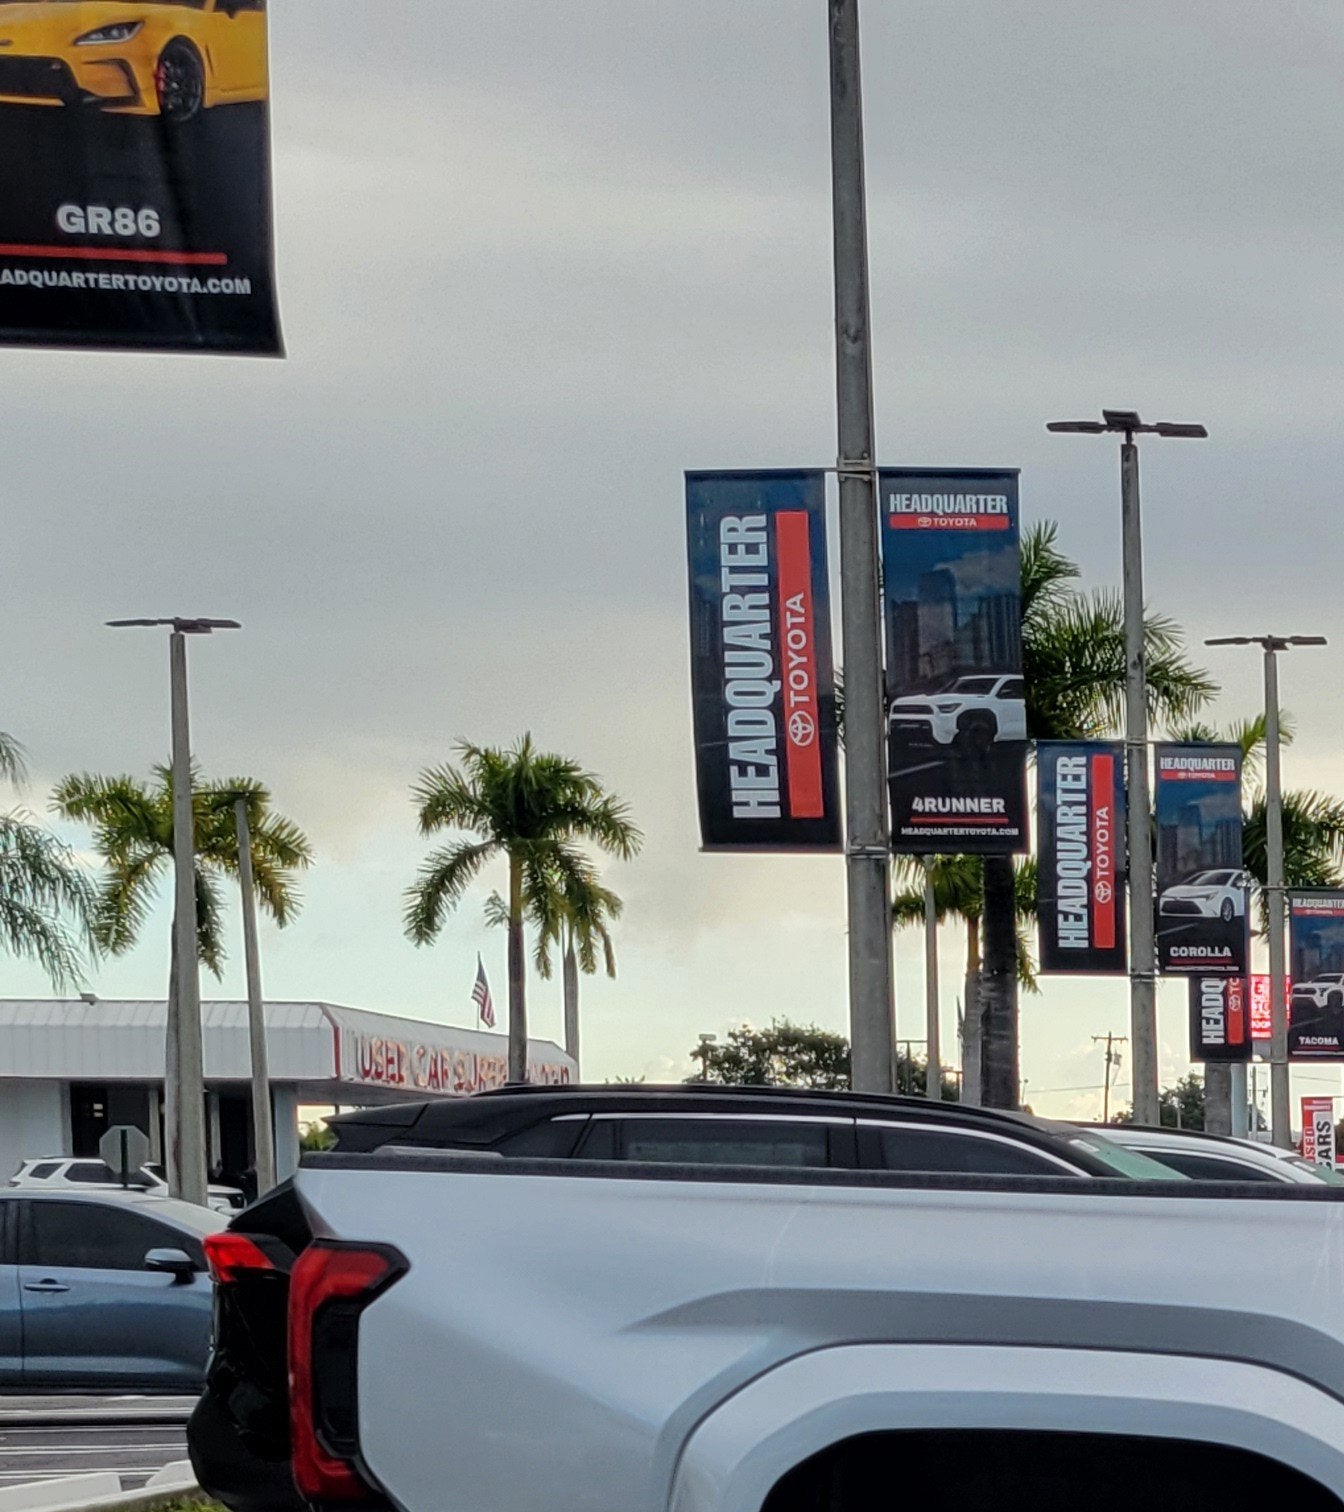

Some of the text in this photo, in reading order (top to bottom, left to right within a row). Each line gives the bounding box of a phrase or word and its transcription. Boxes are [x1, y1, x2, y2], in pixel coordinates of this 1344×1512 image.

[57, 204, 161, 238] GR86
[889, 493, 1009, 515] HEADQUARTER
[934, 517, 978, 527] TOYOTA
[720, 513, 782, 819] HEADQUARTER
[785, 592, 810, 708] TOYOTA
[1160, 756, 1236, 772] HEADQUARTER
[912, 796, 1005, 813] 4RUNNER
[1056, 755, 1092, 948] HEADQUARTER
[1096, 806, 1109, 878] TOYOTA
[1169, 946, 1232, 957] COROLLA
[1200, 977, 1227, 1044] HEADQ
[1298, 1036, 1339, 1045] TACOMA
[356, 1034, 406, 1084] USED
